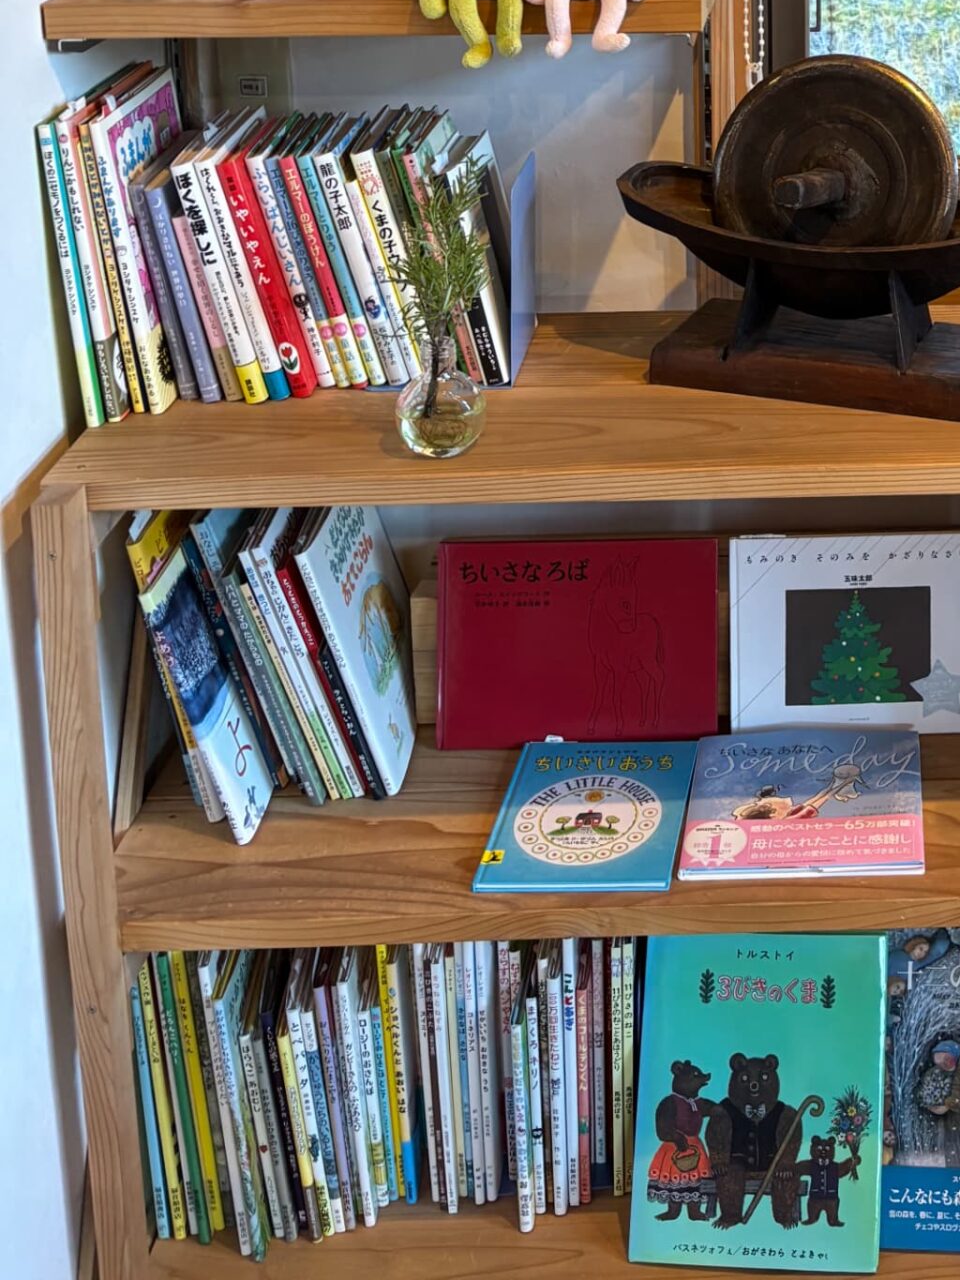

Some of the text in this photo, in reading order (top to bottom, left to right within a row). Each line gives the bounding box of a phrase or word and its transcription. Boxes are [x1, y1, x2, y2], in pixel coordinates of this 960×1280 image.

[44, 150, 70, 258] ぼくのニセモノをつくるには
[62, 148, 85, 232] りんごかもしれない
[97, 156, 122, 238] ふまんがあります
[176, 171, 217, 267] ぼくを探しに
[284, 168, 325, 268] エルマーのぼうけん
[301, 167, 336, 253] エルマーとりゅう
[320, 162, 352, 231] 龍の子太郎
[229, 195, 271, 286] いやいやえん
[253, 167, 301, 287] ふらいぱんじいさん
[270, 169, 313, 283] エルマーと16ぴきのりゅう
[63, 267, 77, 316] ヨシタケシンスケ
[83, 263, 97, 312] ヨシタケシンスケ
[108, 262, 125, 324] ヨシタケシンスケ
[121, 262, 139, 324] ヨシタケシンスケ
[459, 558, 590, 582] ちいさな ろば
[745, 552, 797, 565] もみのき
[816, 551, 870, 562] そのみを
[844, 574, 873, 583] 五味太郎
[534, 754, 674, 772] ちいさいおうち
[703, 735, 921, 788] Someday
[777, 743, 834, 756] あなたへ
[529, 776, 657, 808] THE LITTLE HOUSE
[752, 834, 912, 851] 母になれたことに感謝し
[736, 948, 794, 961] トルストイ
[564, 973, 574, 1031] こんとあき
[624, 983, 633, 1038] 11ぴきのねこ
[716, 976, 818, 1005] 3びきのくま
[290, 1022, 309, 1090] とべバッタ
[359, 1019, 374, 1096] ロージーのおさんぽ
[389, 1005, 407, 1113] ショベルくんと あおい はな
[467, 1011, 475, 1053] コーネリアス
[527, 1006, 540, 1090] まっくろ ネリノ
[548, 991, 560, 1071] 100万回生きたねこ
[577, 993, 588, 1091] くまのコールテンくん
[612, 987, 623, 1071] 11ぴきのねことあほうどり
[241, 1045, 261, 1113] はらぺこ あおむし
[673, 1243, 725, 1255] バスネツォフ
